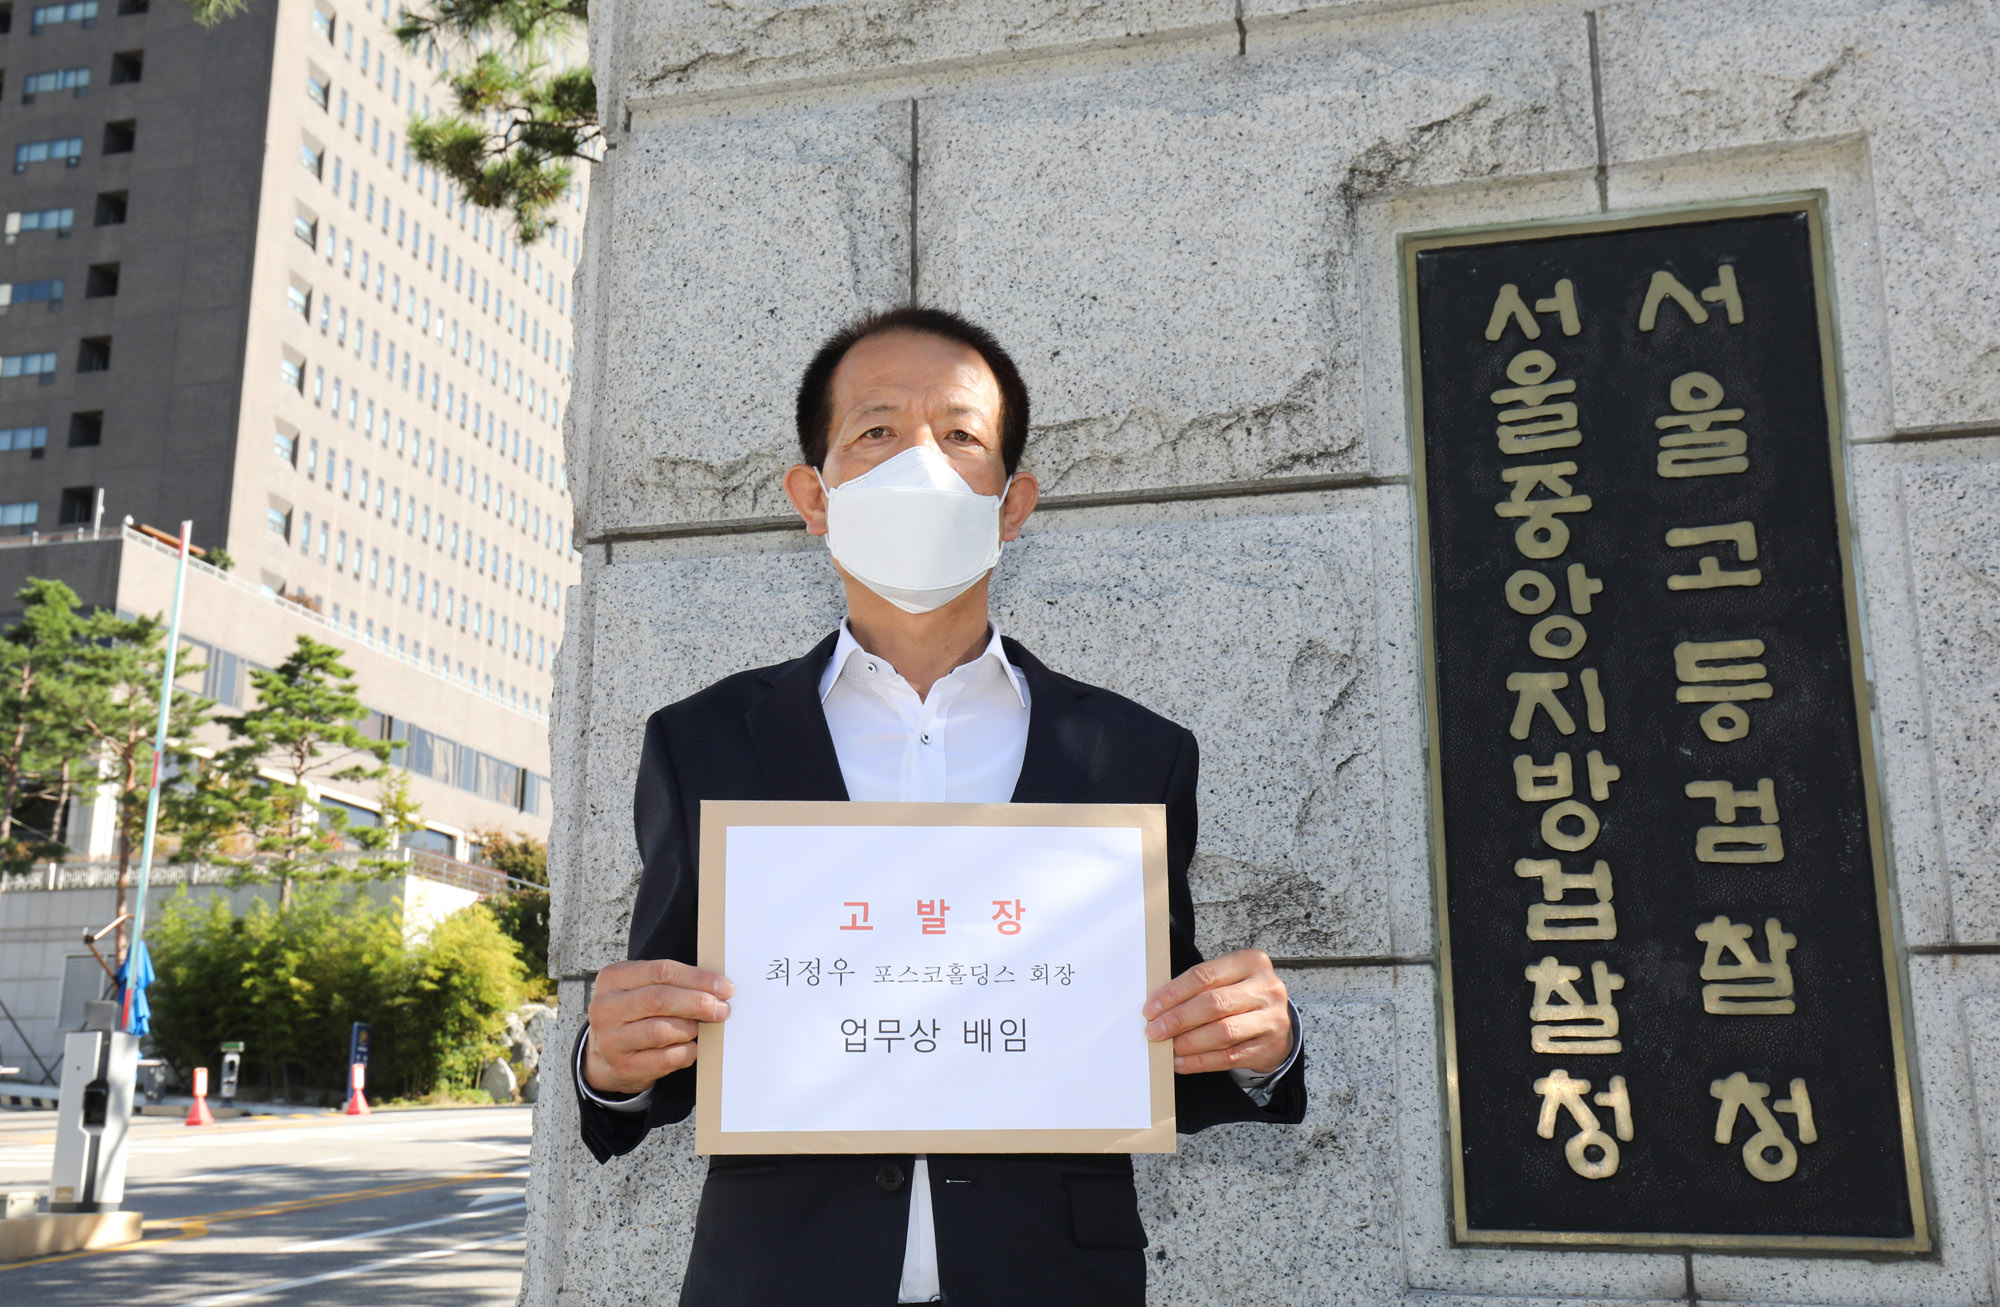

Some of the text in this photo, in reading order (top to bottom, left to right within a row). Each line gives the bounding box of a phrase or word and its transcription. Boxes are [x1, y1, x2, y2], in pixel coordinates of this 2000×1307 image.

[1485, 278, 1634, 1179] 서울중앙지방검찰청
[1638, 264, 1818, 1182] 서울고등검찰청
[765, 957, 1076, 987] 최정우 포스코홀딩스 회장
[840, 1017, 1028, 1053] 업무상 배임
